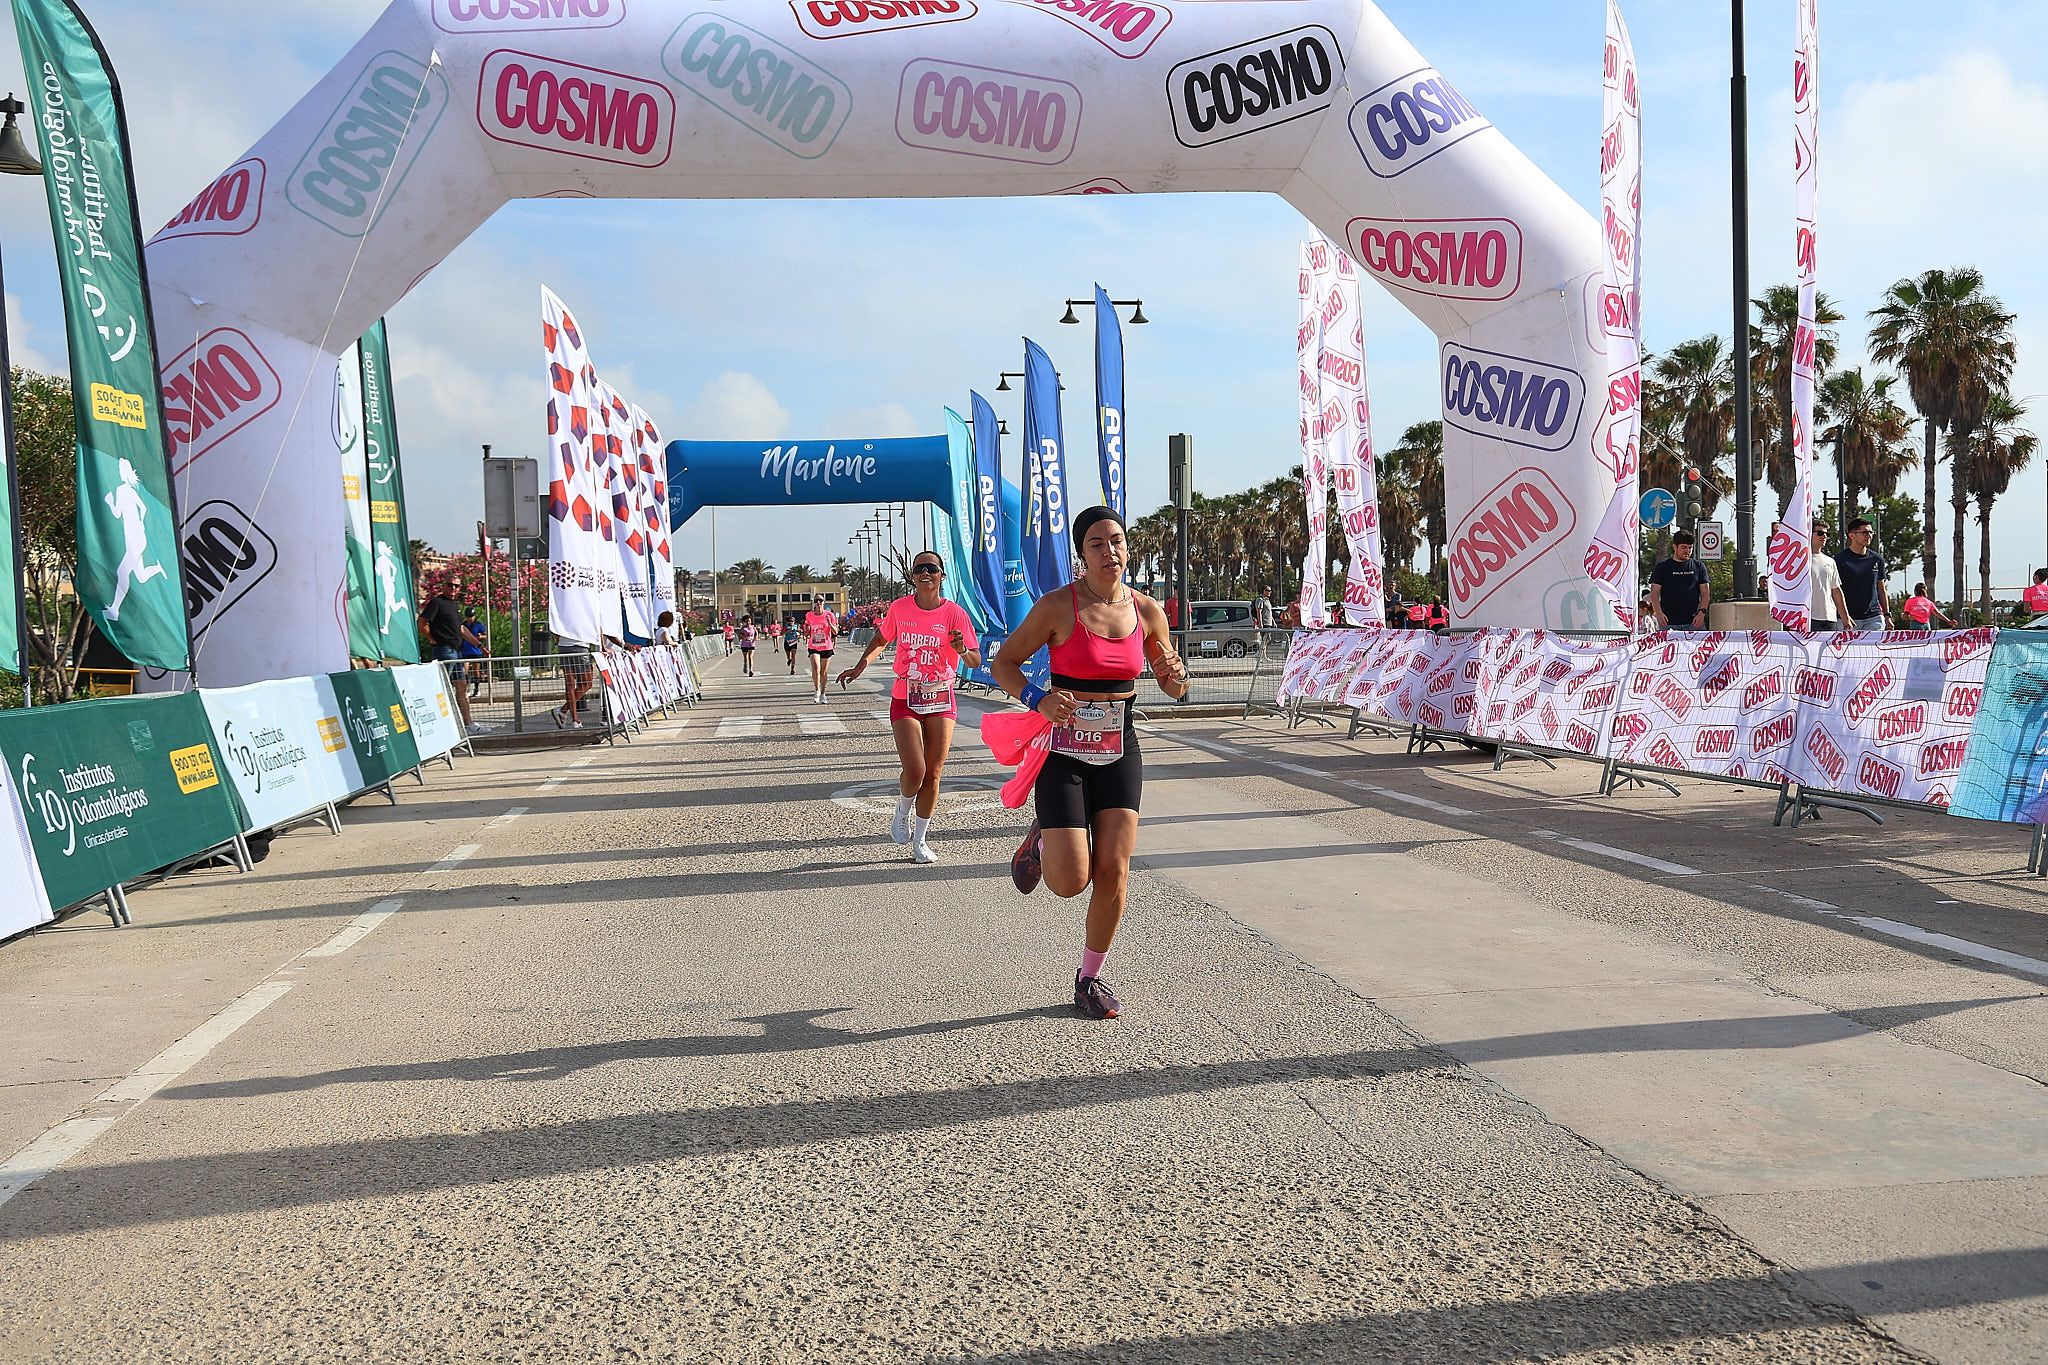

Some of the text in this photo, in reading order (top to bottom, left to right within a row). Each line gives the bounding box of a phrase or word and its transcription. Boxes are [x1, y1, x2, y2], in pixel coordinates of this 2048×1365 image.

[679, 22, 836, 144] COSMO
[1183, 36, 1333, 133] COSMO
[494, 63, 659, 155] COSMO
[913, 71, 1067, 153] COSMO
[1366, 75, 1482, 160] COSM
[302, 65, 430, 218] COSMO
[1361, 229, 1507, 288] COSMO
[165, 344, 262, 445] SMO
[1445, 355, 1570, 437] COSMO
[760, 443, 876, 496] Marlene
[1449, 482, 1559, 604] COSMO
[1705, 537, 1716, 545] 30
[901, 632, 941, 648] CARRERA
[922, 691, 938, 700] 016
[1583, 685, 1615, 710] COSMO
[1655, 679, 1692, 718] COSMO
[1703, 657, 1739, 703] COSMO
[1744, 670, 1781, 709] COSMO
[1795, 669, 1834, 701] COSMO
[1848, 664, 1891, 721] COSMO
[1420, 703, 1443, 728] COSMO
[1948, 687, 1983, 717] COS
[1075, 730, 1102, 742] 016
[1566, 723, 1596, 755] COSMO
[1695, 730, 1735, 753] COSMO
[1754, 714, 1794, 753] COSMO
[1878, 705, 1924, 740] COSMO
[1807, 728, 1845, 782] COSMO
[1921, 740, 1968, 774] COSM
[59, 763, 116, 794] Institutos
[1860, 757, 1900, 798] COSMO
[72, 786, 149, 826] Odontológicos
